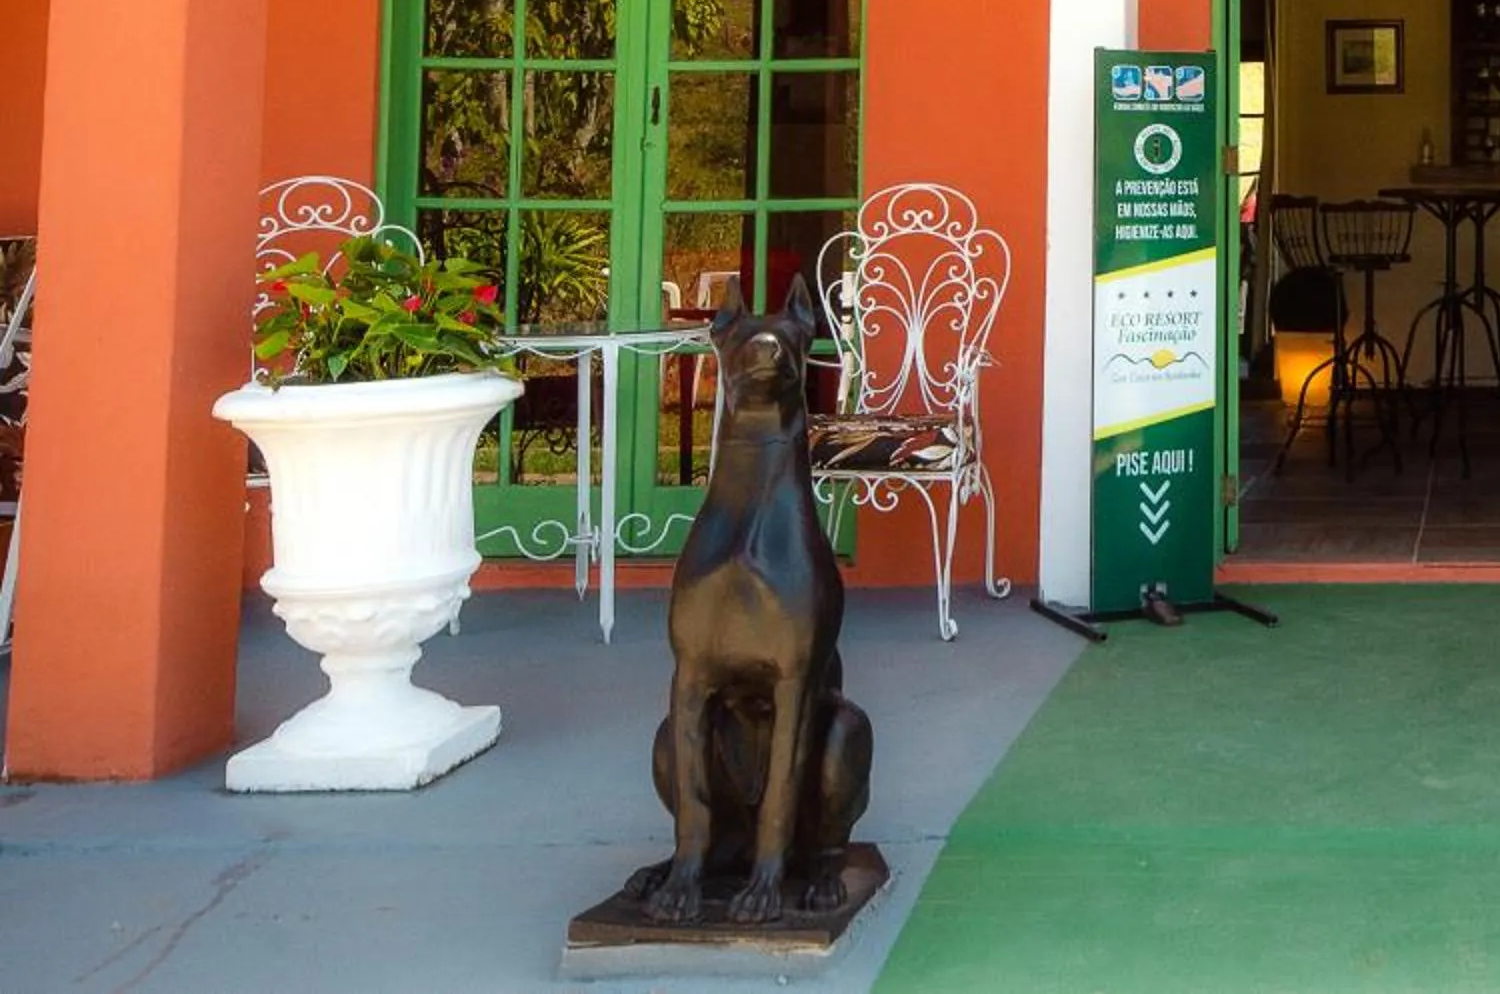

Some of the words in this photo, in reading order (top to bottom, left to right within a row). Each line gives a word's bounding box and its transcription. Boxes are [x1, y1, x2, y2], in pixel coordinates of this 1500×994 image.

[1115, 179, 1123, 196] A
[1124, 177, 1176, 197] PREVENÇÃO
[1178, 177, 1199, 195] ESTÁ
[1117, 202, 1132, 218] EM
[1133, 201, 1168, 218] NOSSAS
[1111, 312, 1142, 327] ECO
[1144, 310, 1203, 327] RESORT
[1116, 452, 1149, 477] PISE
